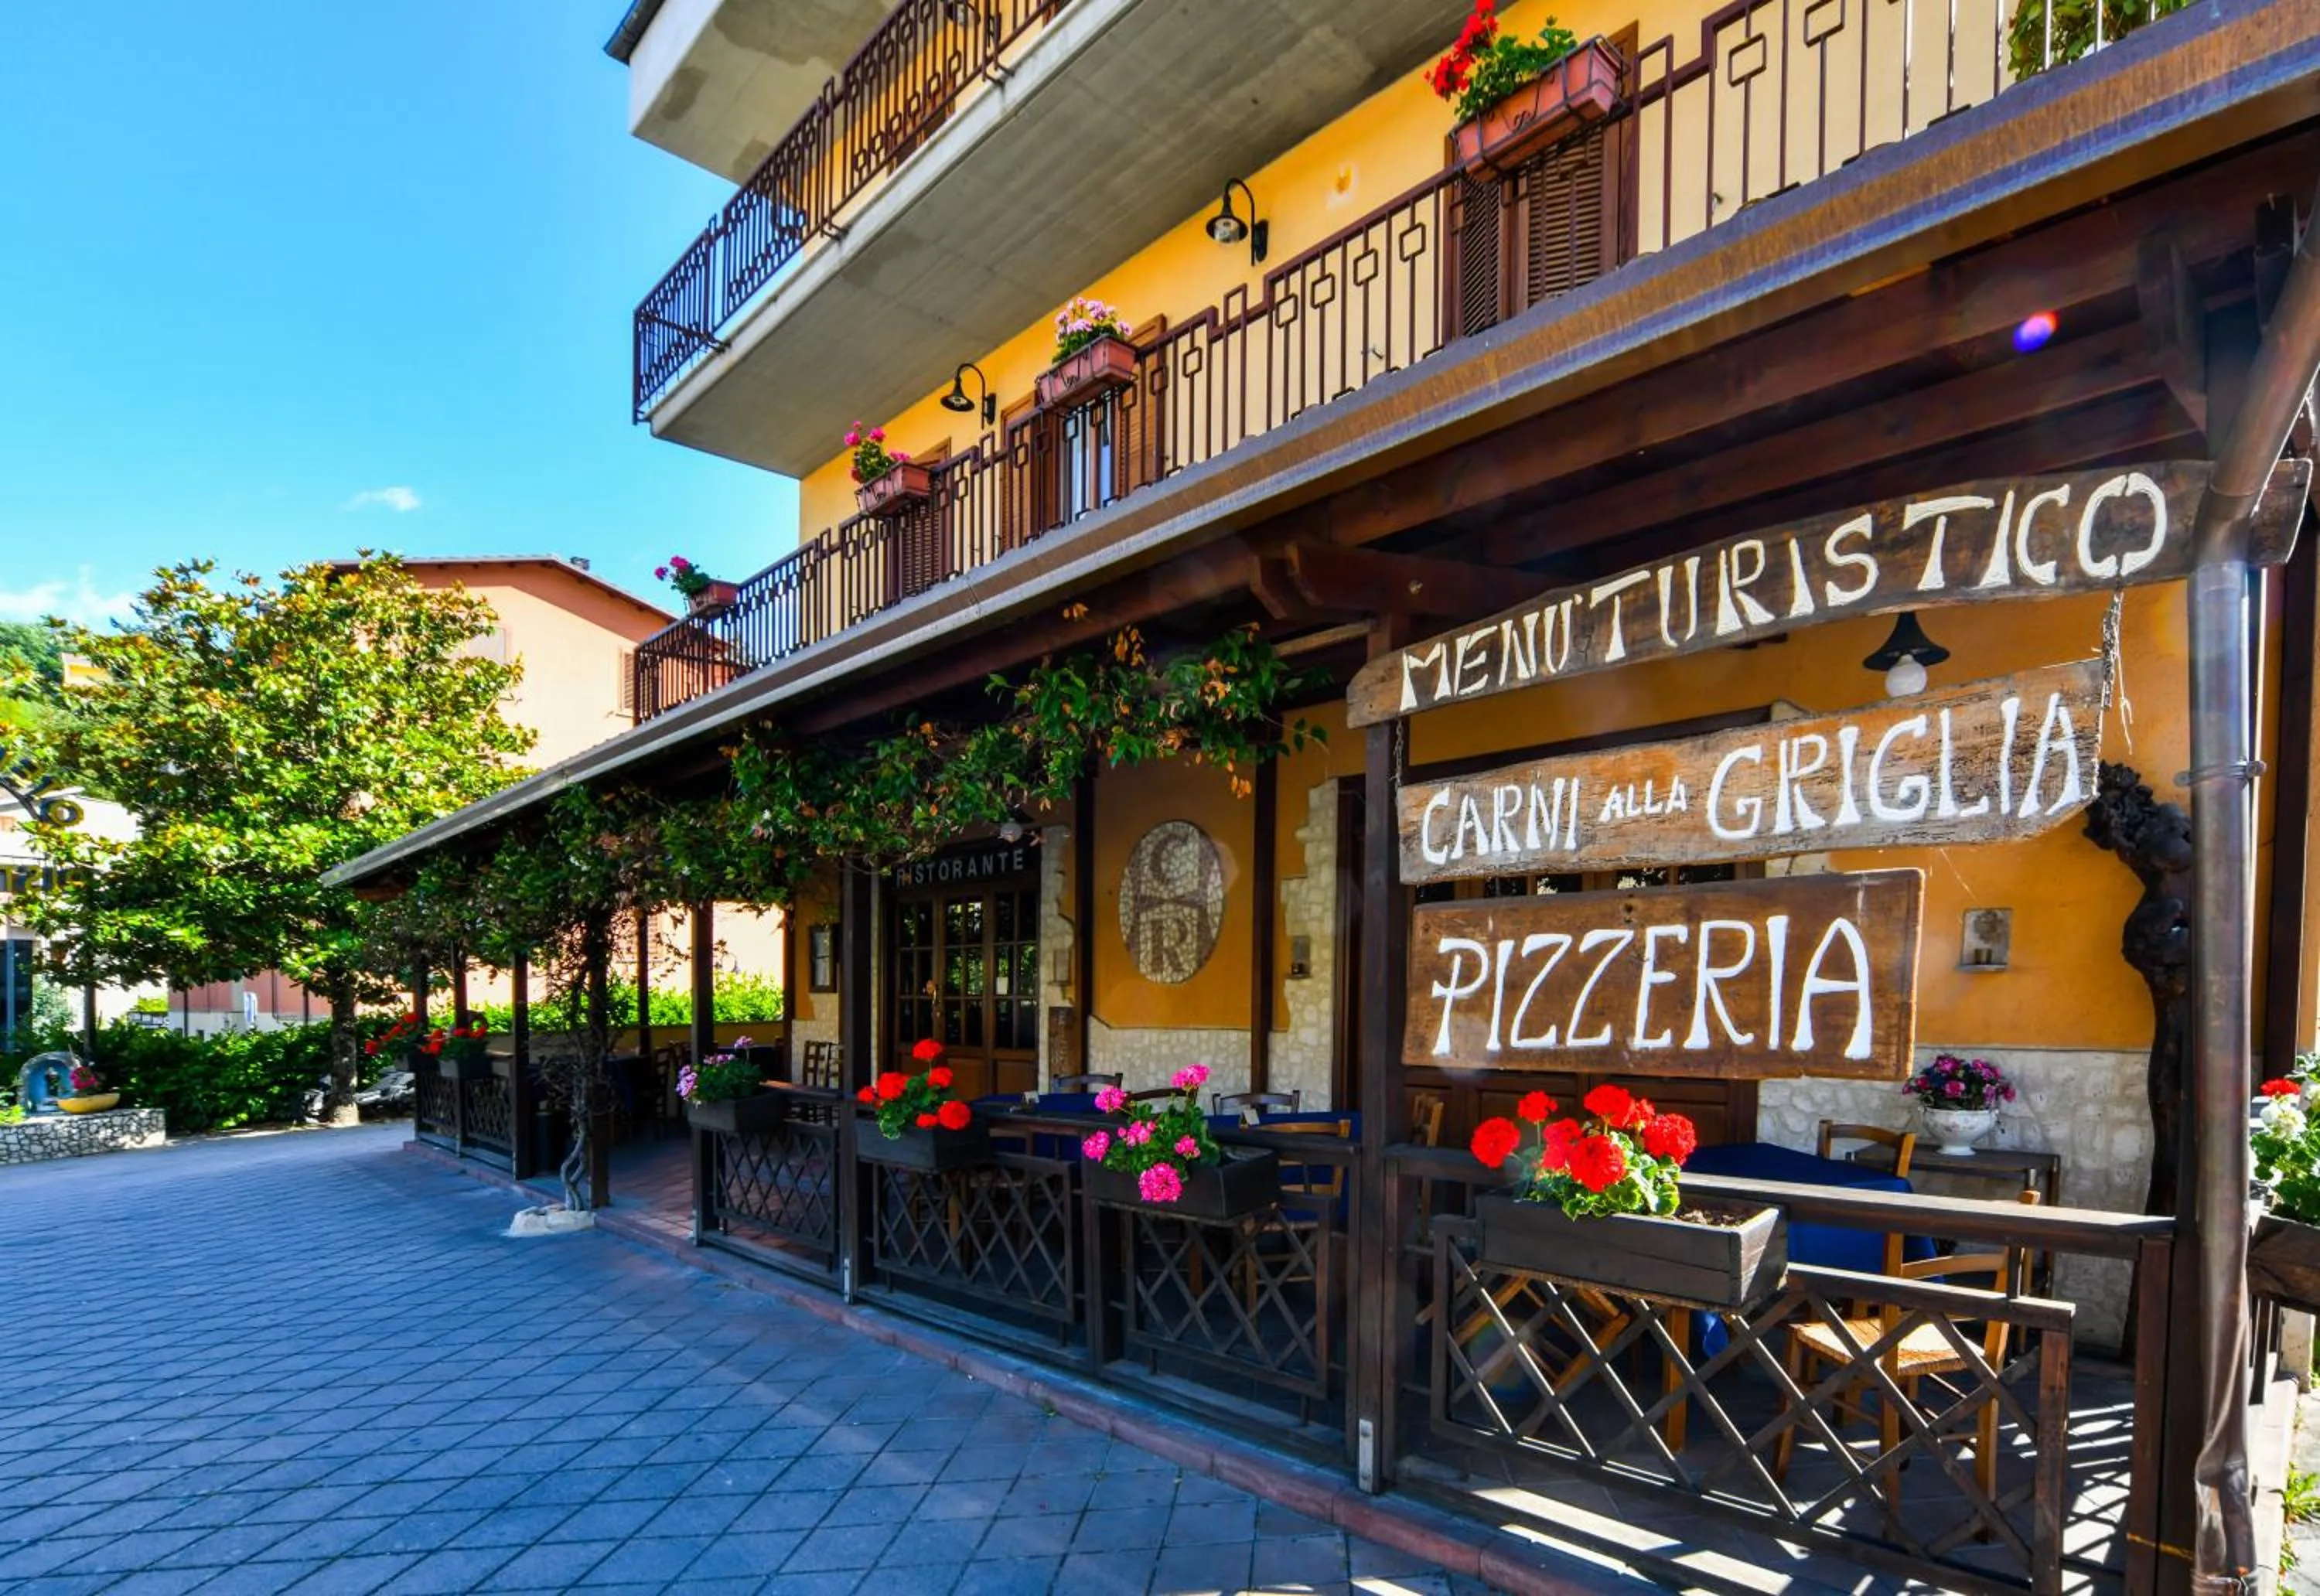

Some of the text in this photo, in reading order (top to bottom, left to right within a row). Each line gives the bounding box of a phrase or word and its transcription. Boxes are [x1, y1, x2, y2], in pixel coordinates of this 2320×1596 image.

[1589, 472, 2168, 663] TURISTICO
[1421, 691, 2090, 865] CARNI ALLA GRIGLIA
[1431, 915, 1873, 1060] PIZZERIA
